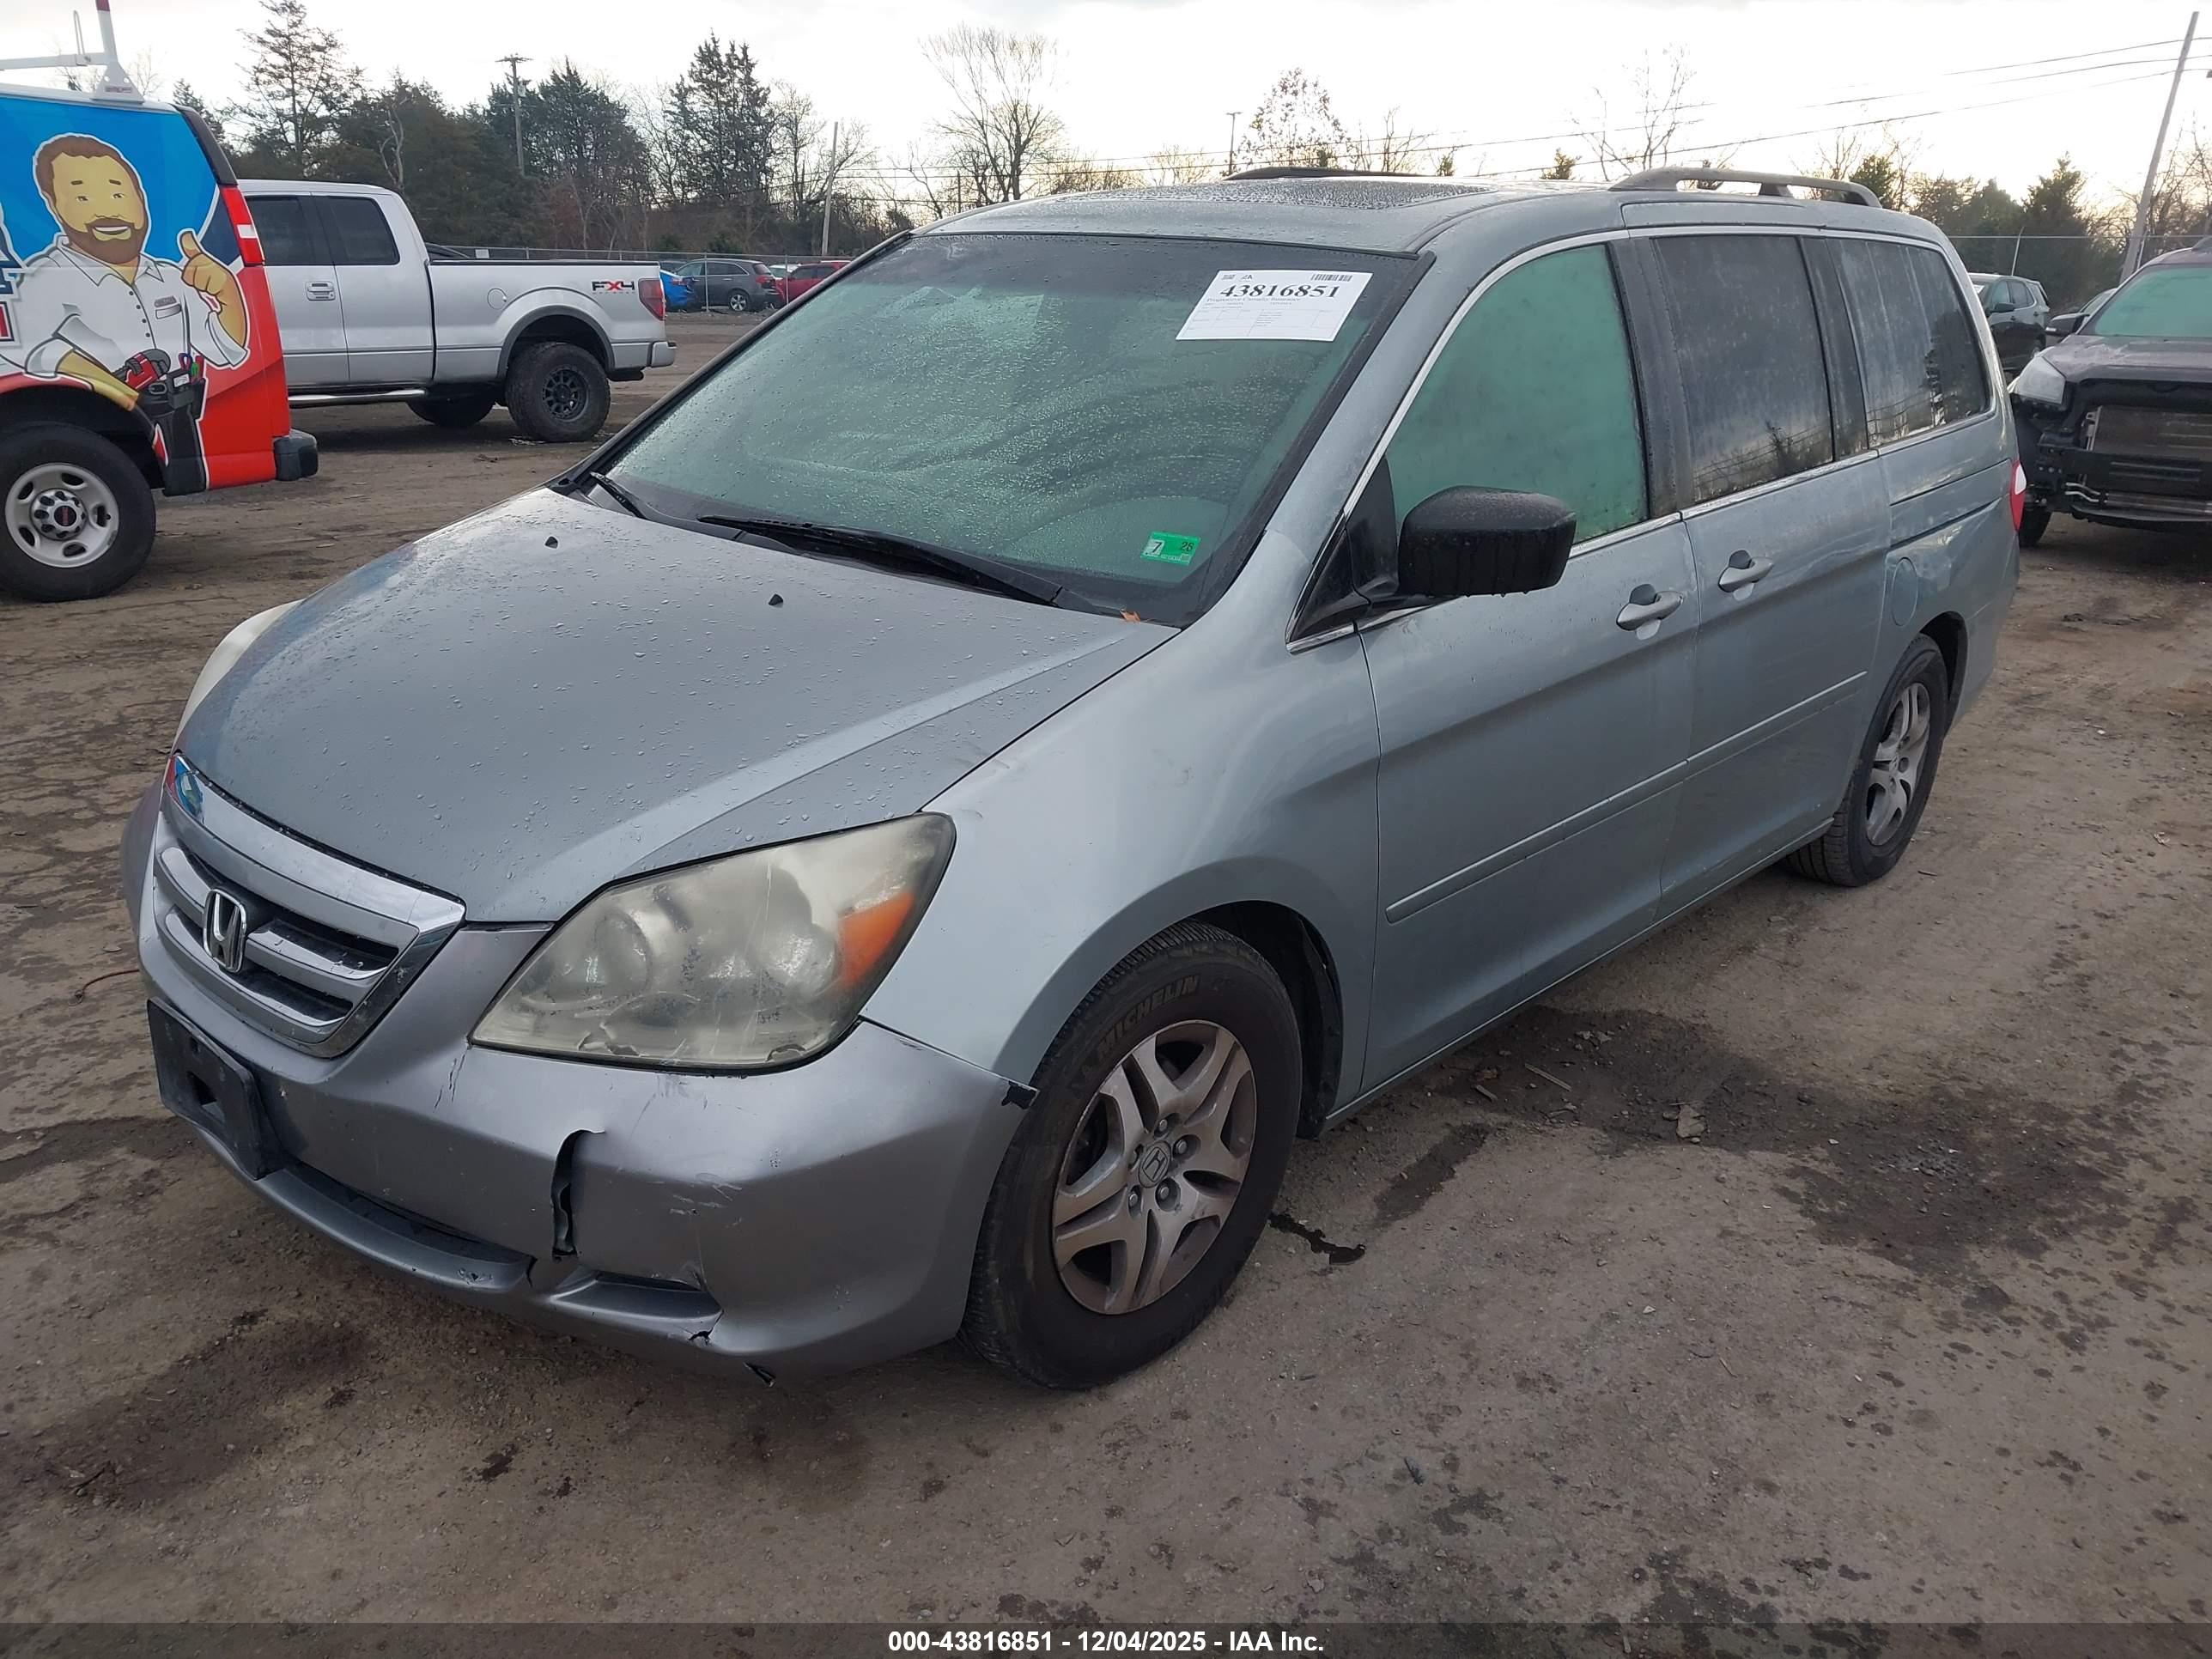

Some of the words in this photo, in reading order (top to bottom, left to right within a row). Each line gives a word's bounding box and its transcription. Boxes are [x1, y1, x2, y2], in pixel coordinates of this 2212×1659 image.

[592, 281, 635, 291] FX4
[1220, 284, 1340, 298] 43816851
[1151, 541, 1163, 553] 7
[1099, 974, 1200, 1057] MICHELIN
